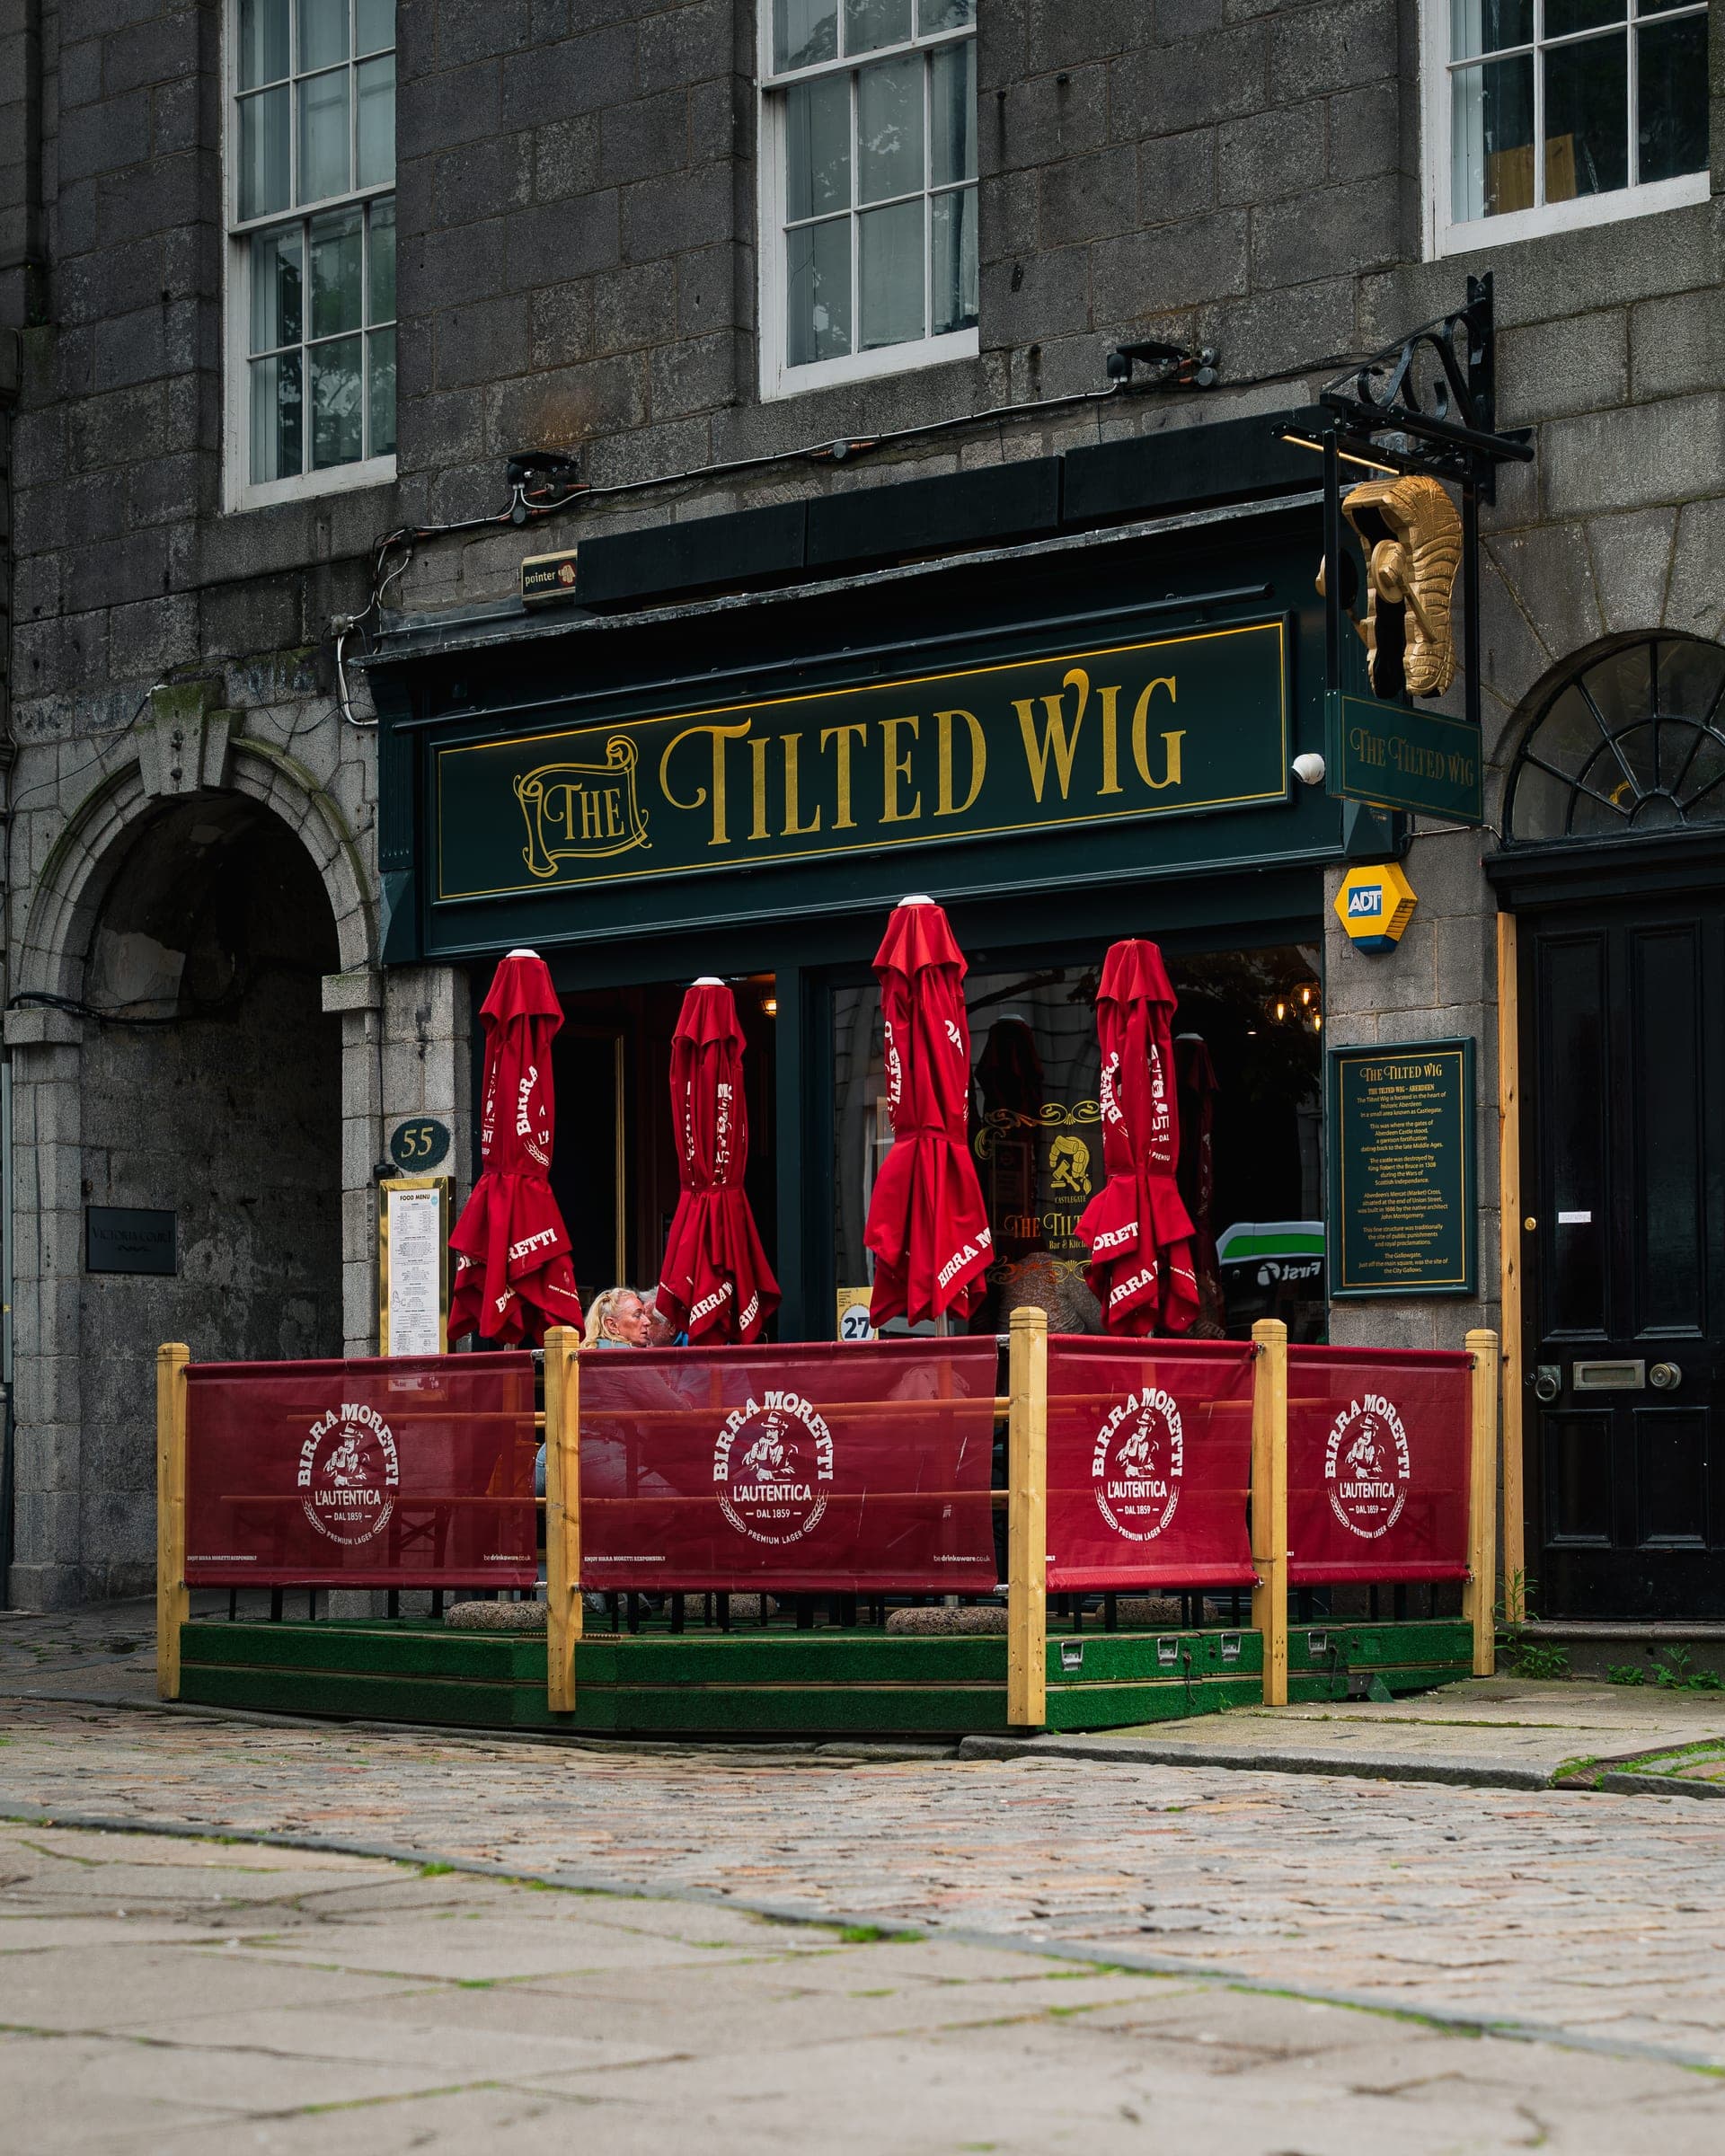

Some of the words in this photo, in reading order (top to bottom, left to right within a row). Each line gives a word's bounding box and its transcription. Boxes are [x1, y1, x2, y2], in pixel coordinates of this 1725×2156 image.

[525, 571, 556, 587] pointer
[543, 782, 625, 841] THE
[659, 710, 987, 845] TILTED
[1012, 668, 1187, 804] WIG
[1349, 727, 1386, 767] THE
[1388, 736, 1445, 780] TILTED
[1447, 750, 1474, 787] WIG
[1349, 890, 1381, 913] ADT
[1359, 1067, 1383, 1082] THE
[1384, 1065, 1421, 1080] TILTED
[1424, 1063, 1442, 1077] WIG
[1409, 1083, 1435, 1092] ABERDEEN
[401, 1127, 434, 1158] 55
[1055, 1195, 1086, 1204] CASTLEGATE
[1004, 1215, 1040, 1238] THE
[1049, 1241, 1059, 1250] Bar
[1062, 1240, 1067, 1249] &
[937, 1244, 979, 1289] BIRRA
[1110, 1268, 1154, 1308] IRRA
[844, 1317, 870, 1339] 27
[712, 1398, 761, 1481] BIRRA
[764, 1392, 834, 1480] MORETTI
[1092, 1394, 1139, 1478] BIRRA
[1141, 1388, 1184, 1477] MORETTI
[1325, 1401, 1360, 1479] BIRRA
[1362, 1393, 1411, 1480] MORETTI
[297, 1410, 338, 1487] BIRRA
[341, 1403, 400, 1487] MORETTI
[314, 1489, 382, 1507] L'AUTENTICA
[733, 1484, 812, 1503] L'AUTENTICA
[1108, 1480, 1167, 1499] L'AUTENTICA
[1339, 1481, 1395, 1499] L'AUTENTICA
[333, 1513, 347, 1522] DAL
[347, 1511, 363, 1522] 1859
[756, 1510, 771, 1519] DAL
[772, 1508, 791, 1519] 1859
[1124, 1506, 1136, 1515] DAL
[1137, 1506, 1151, 1515] 1859
[1355, 1505, 1367, 1515] DAL
[1367, 1505, 1379, 1515] 1859
[326, 1531, 353, 1546] PREMIUM
[354, 1531, 374, 1546] LAGER
[747, 1529, 780, 1545] PREMIUM
[781, 1530, 804, 1545] LAGER
[1118, 1525, 1144, 1542] PREMIUM
[1144, 1526, 1162, 1542] LAGER
[1349, 1524, 1374, 1539] PREMIUM
[1374, 1525, 1387, 1539] LAGER
